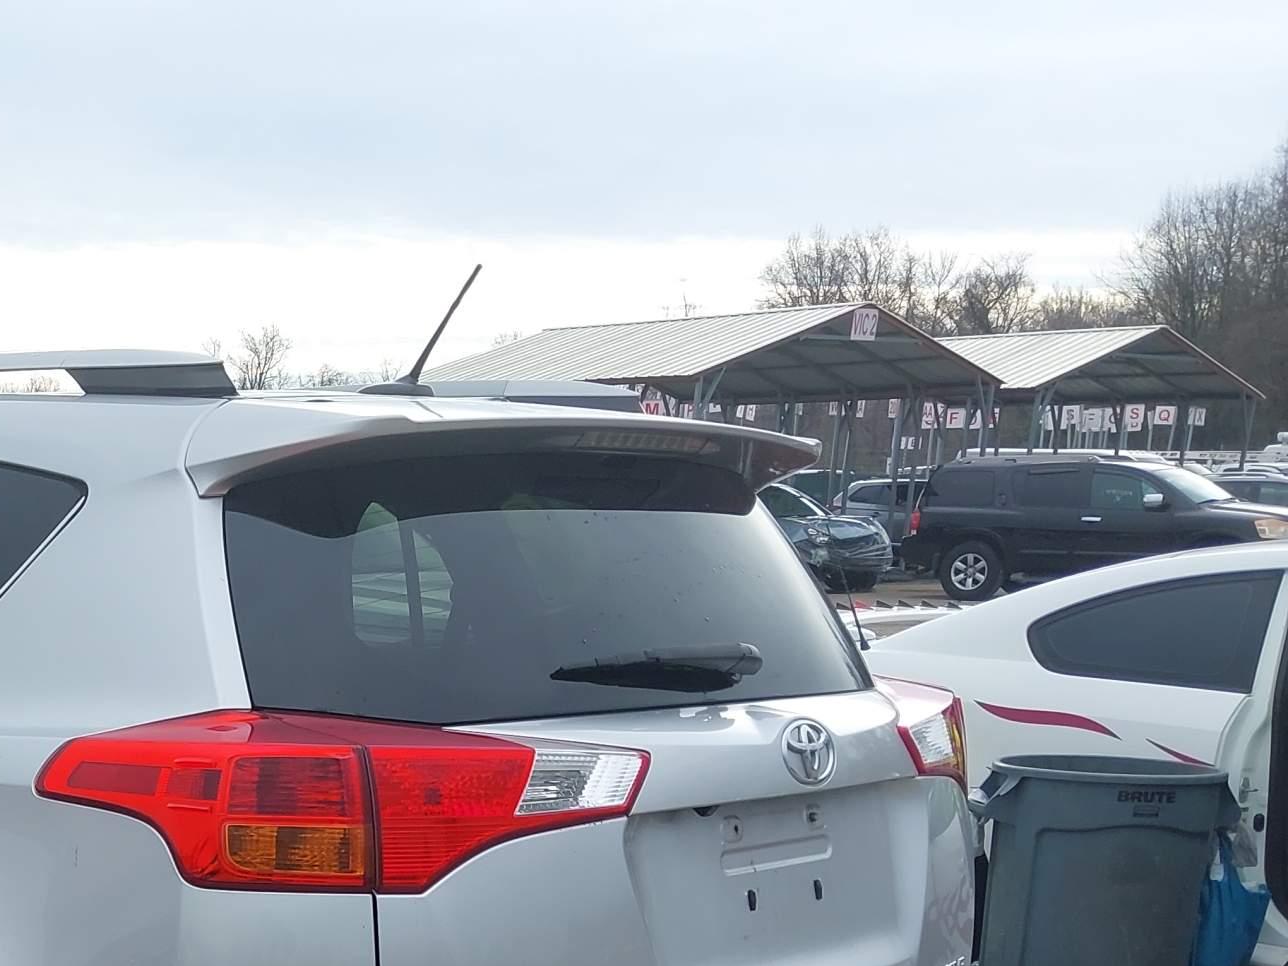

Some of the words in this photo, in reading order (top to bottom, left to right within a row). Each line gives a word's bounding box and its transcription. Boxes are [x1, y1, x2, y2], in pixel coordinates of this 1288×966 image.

[853, 312, 869, 337] VIC
[869, 313, 877, 336] 2
[645, 402, 659, 415] M
[1130, 407, 1140, 420] S
[949, 411, 960, 425] F
[1158, 409, 1171, 422] Q
[1117, 791, 1176, 803] BRUTE
